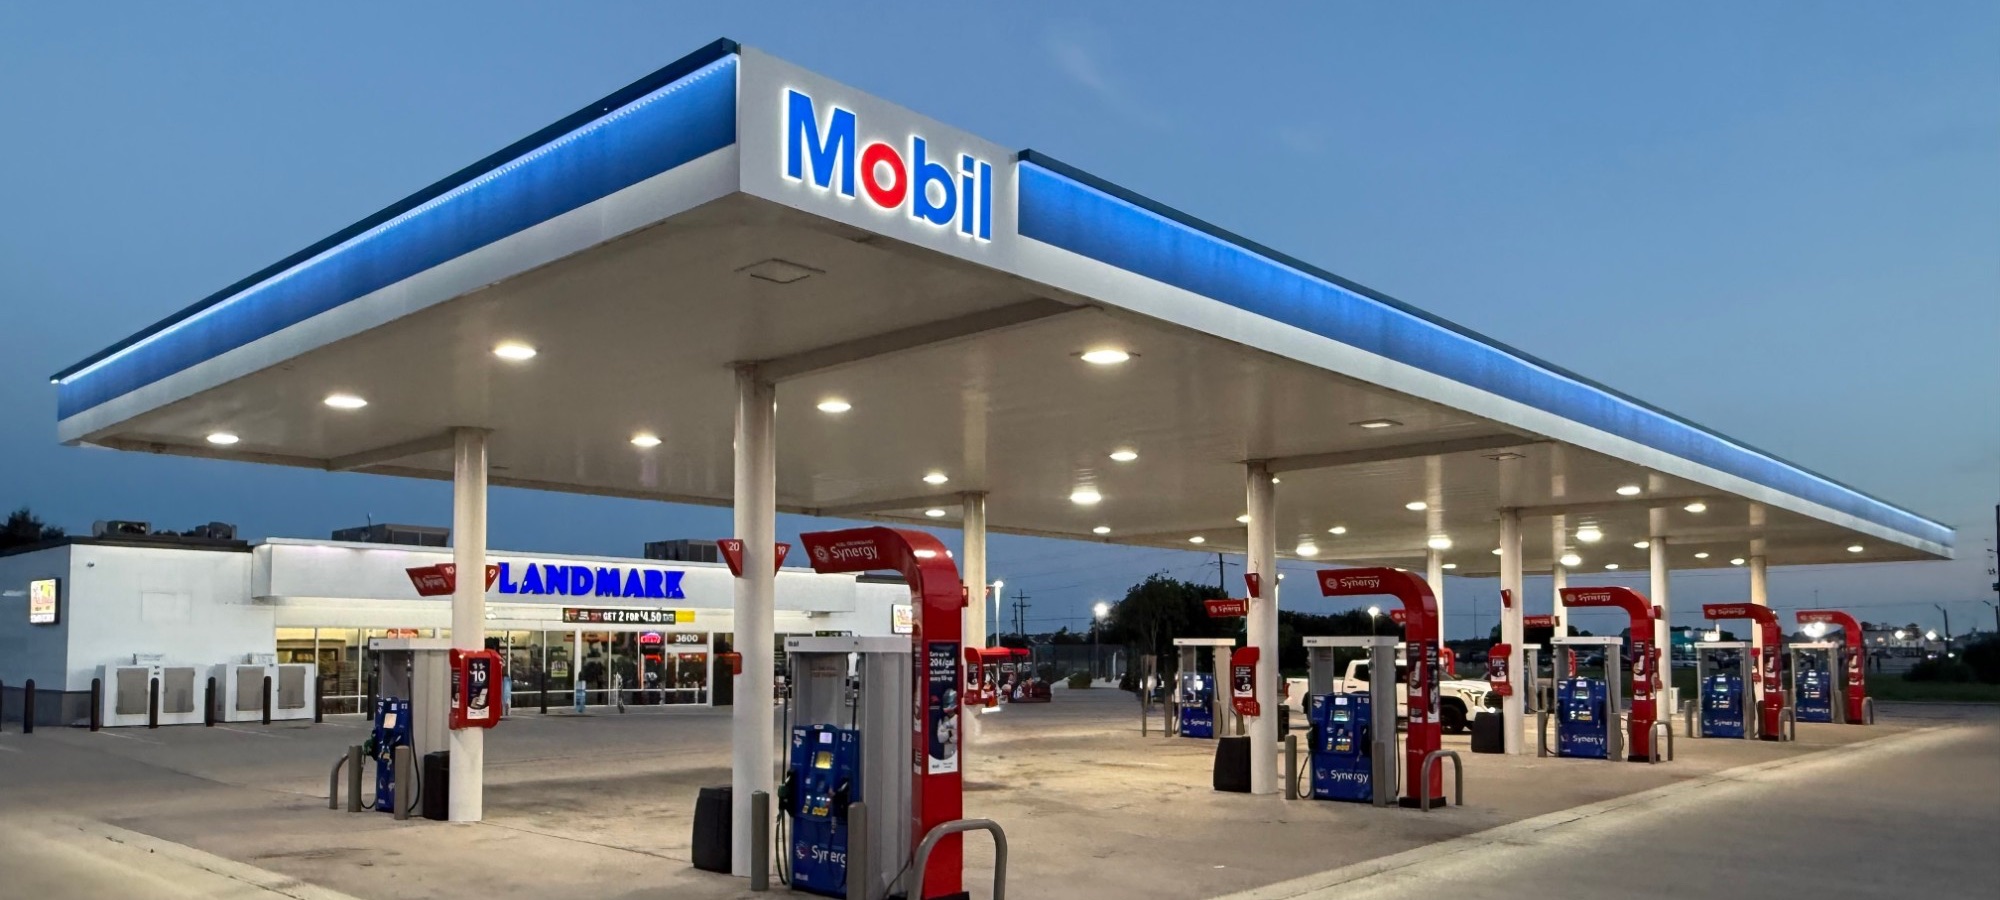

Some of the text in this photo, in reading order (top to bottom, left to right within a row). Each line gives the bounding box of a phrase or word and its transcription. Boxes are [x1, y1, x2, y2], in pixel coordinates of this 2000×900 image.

[786, 87, 992, 242] Mobil
[728, 541, 740, 552] 20
[777, 545, 786, 555] 19
[830, 544, 878, 561] Synergy
[444, 565, 455, 575] 10
[488, 568, 496, 578] 9
[498, 562, 686, 599] LANDMARK
[1340, 578, 1380, 589] Synergy
[602, 612, 617, 621] GET
[618, 611, 624, 622] 2
[625, 612, 640, 621] FOR
[640, 610, 662, 622] $4.50
[675, 634, 698, 643] 3600
[1330, 769, 1369, 783] Synergy
[811, 844, 847, 868] Synerg
